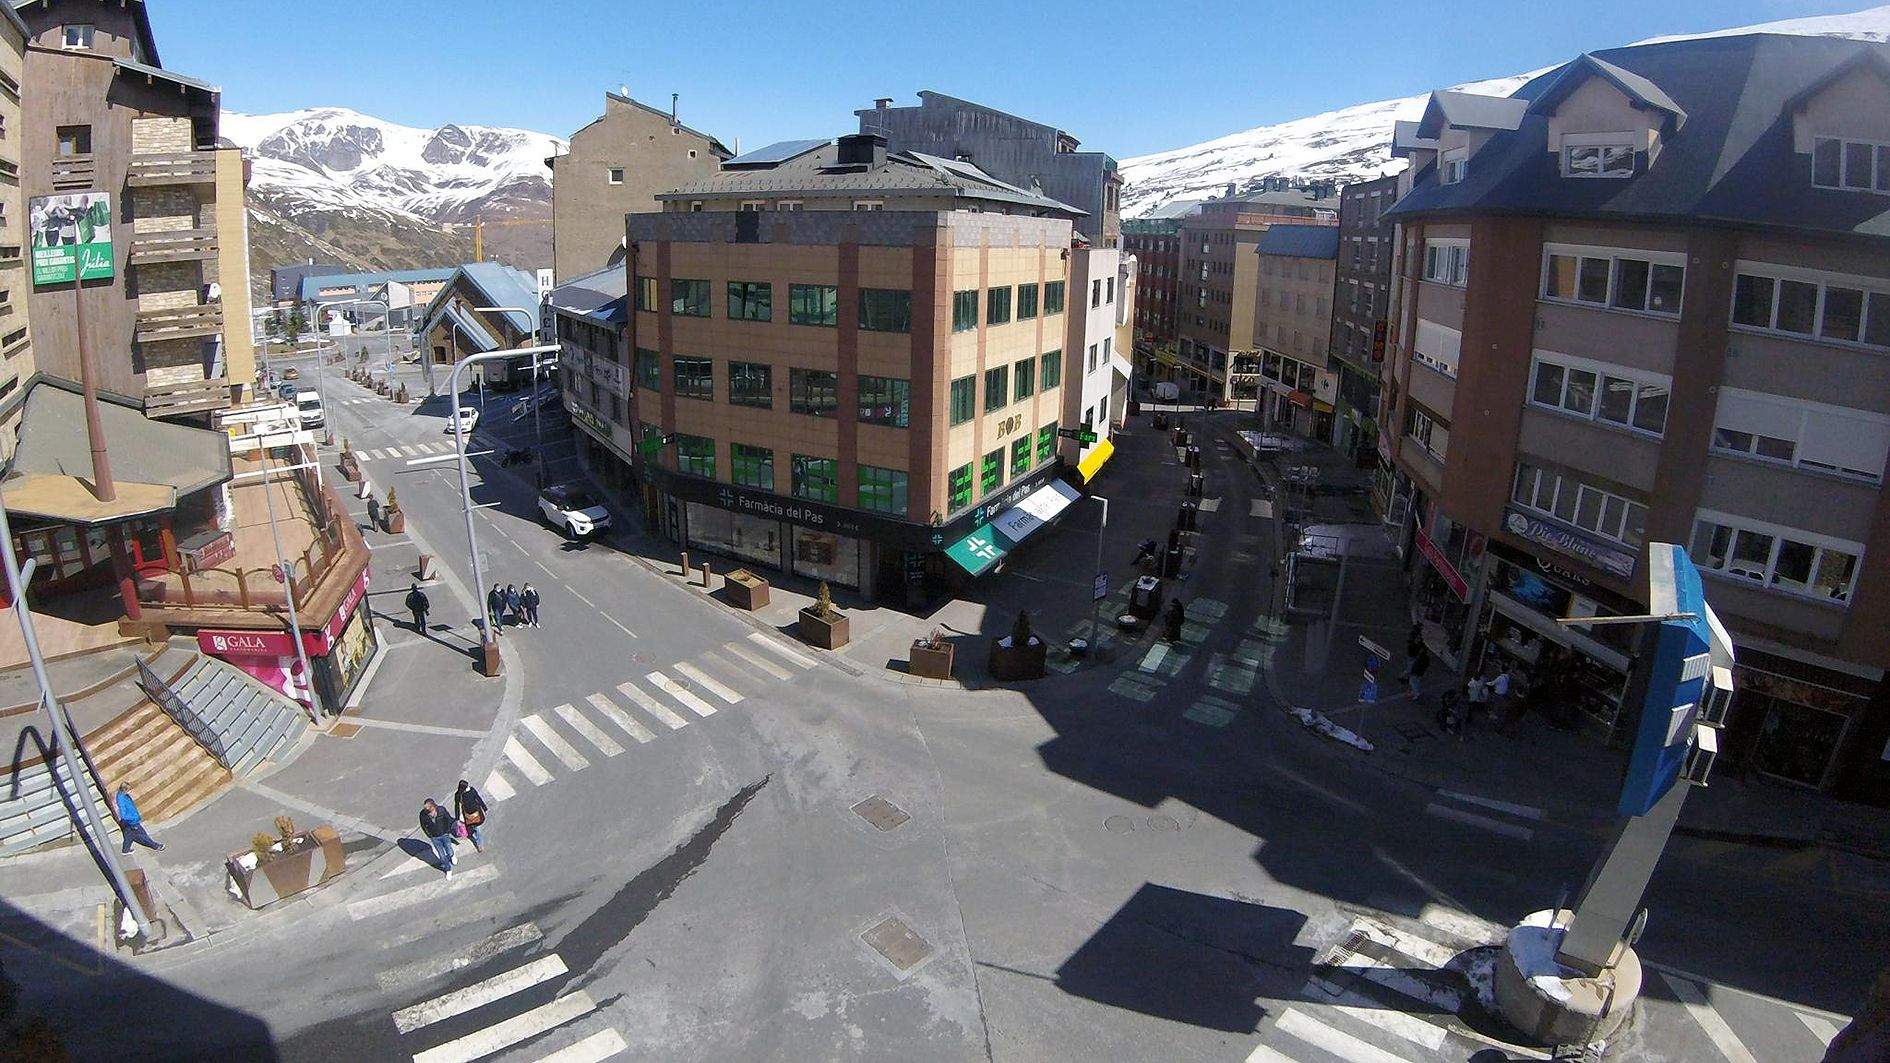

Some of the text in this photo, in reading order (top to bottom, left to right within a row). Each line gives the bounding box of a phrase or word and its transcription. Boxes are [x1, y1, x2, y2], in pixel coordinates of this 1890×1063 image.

[739, 495, 824, 524] Farmàcia del Pas
[227, 635, 266, 648] GALA
